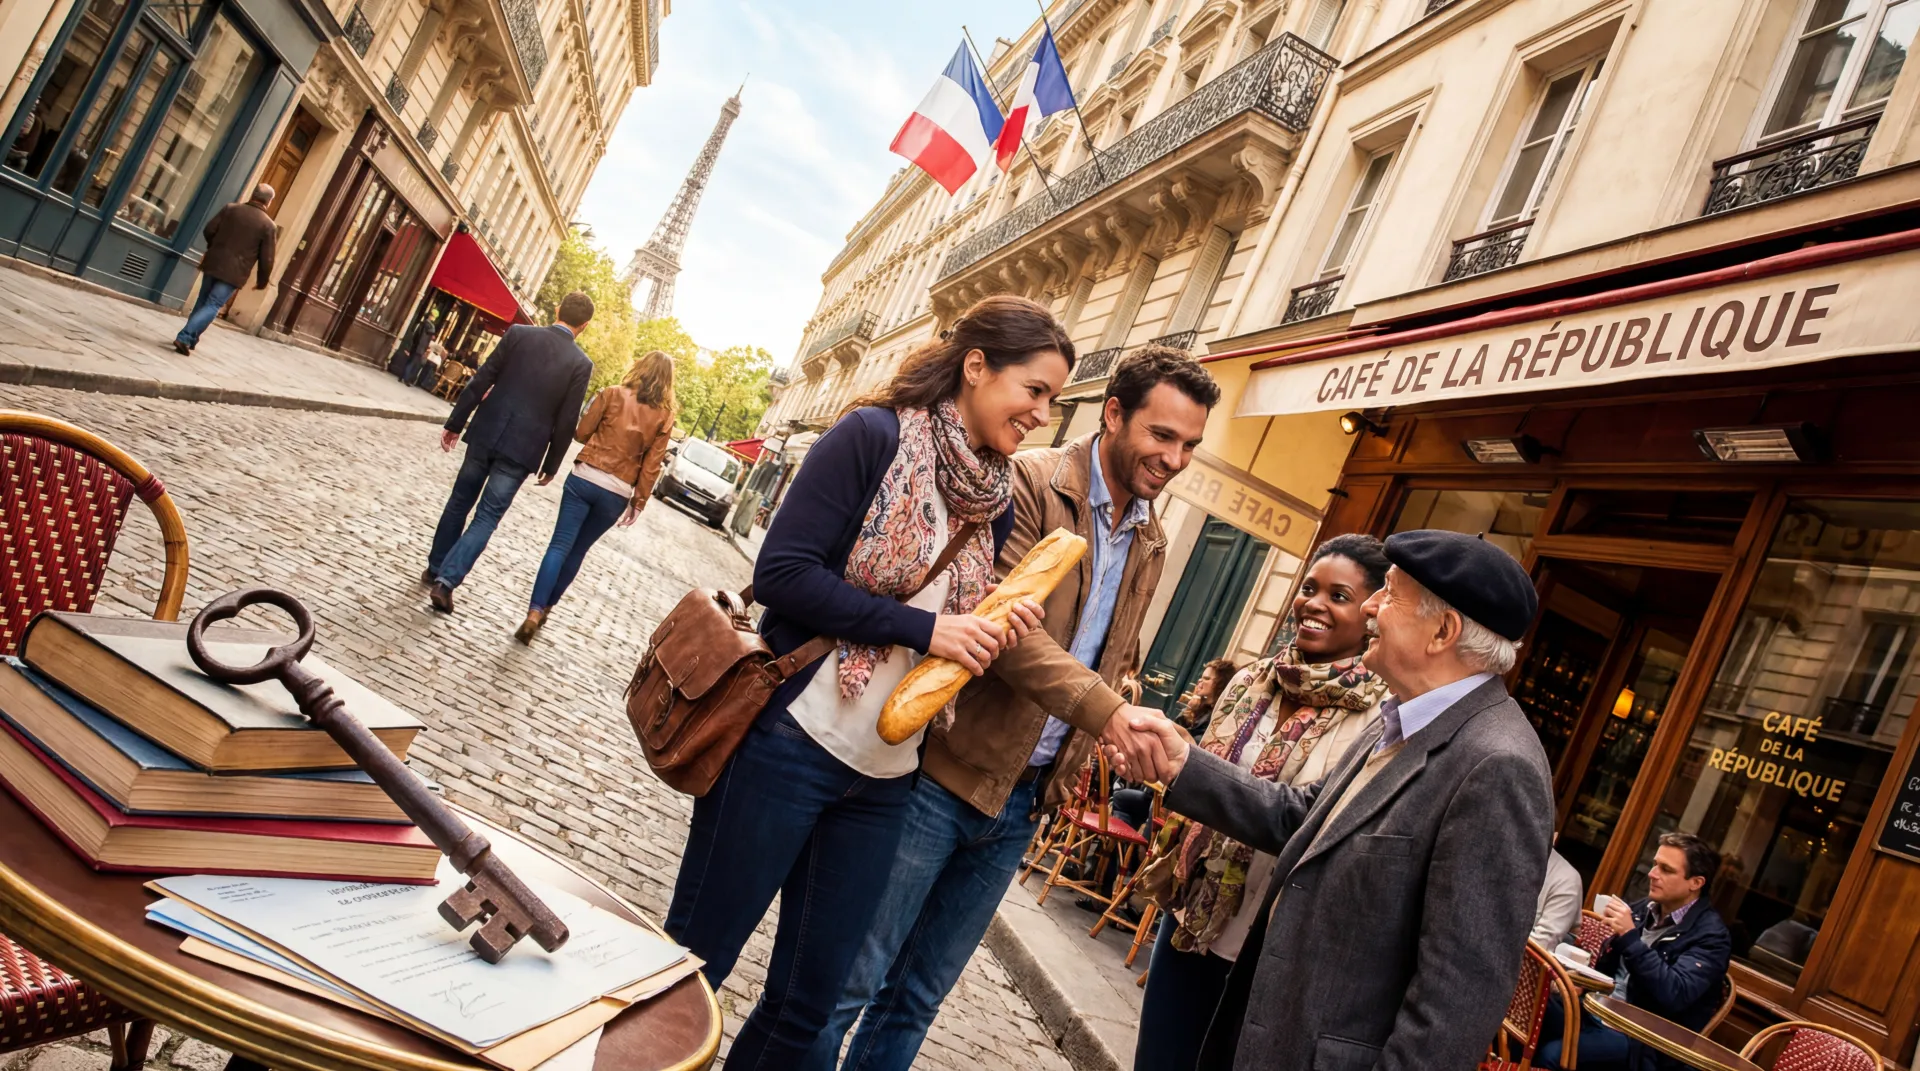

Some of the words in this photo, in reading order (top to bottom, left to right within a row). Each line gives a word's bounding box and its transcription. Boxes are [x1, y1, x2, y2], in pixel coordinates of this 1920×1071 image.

[1316, 350, 1393, 404] CAFÉ
[1391, 351, 1441, 395] DE
[1440, 343, 1490, 389] LA
[1497, 283, 1840, 383] RÉPUBLIQUE
[1762, 711, 1823, 743] CAFÉ
[1759, 738, 1783, 756] DE
[1783, 744, 1804, 762] LA
[1707, 747, 1846, 802] RÉPUBLIQUE
